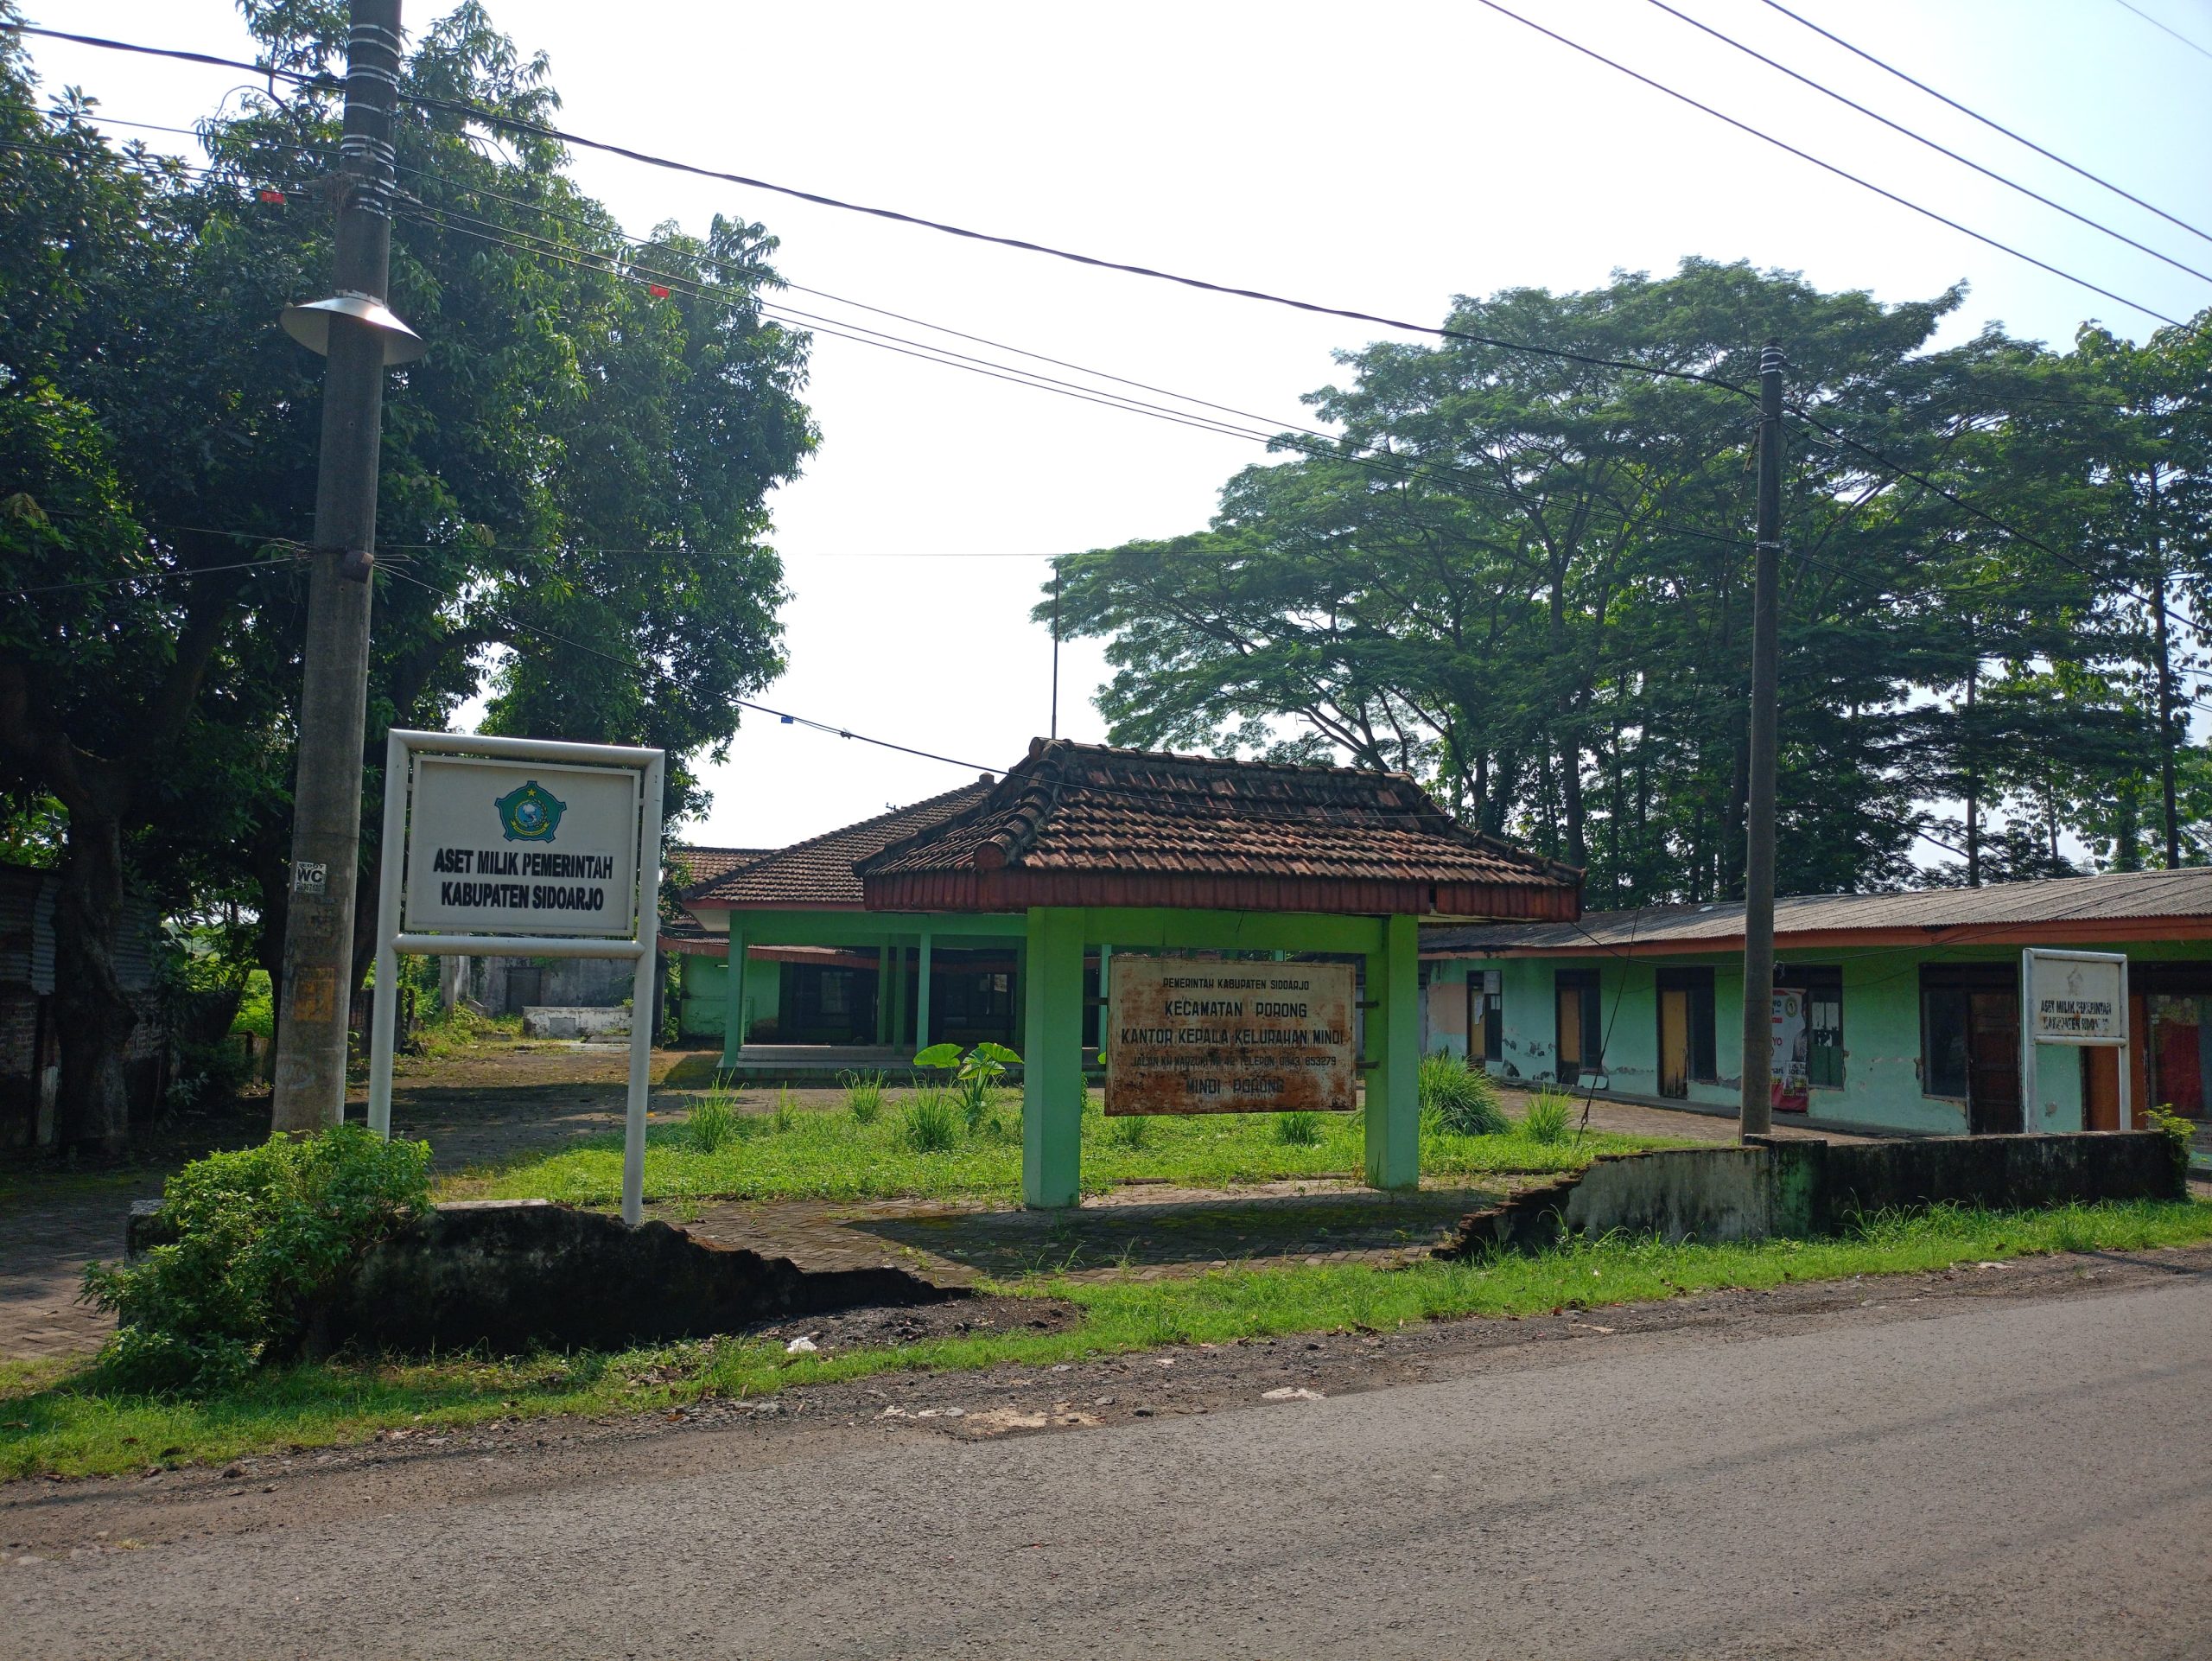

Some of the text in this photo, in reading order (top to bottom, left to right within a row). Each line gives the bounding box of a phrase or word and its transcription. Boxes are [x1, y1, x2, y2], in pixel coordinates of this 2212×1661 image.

[433, 849, 613, 880] ASET MILIK PEMERINTAH
[298, 869, 322, 882] WC
[442, 881, 604, 911] KABUPATEN SIDOARJO
[1163, 977, 1310, 990] PEMERINTAH KABUPATEN SIDOARJO
[1165, 1001, 1307, 1018] KECAMATAN PORONG
[2056, 1000, 2075, 1015] MILIK
[1121, 1028, 1344, 1045] KANTOR KEPALA KELURAHAN MINDI
[1306, 1056, 1337, 1066] 853279
[1186, 1078, 1285, 1094] MINDI PORONG
